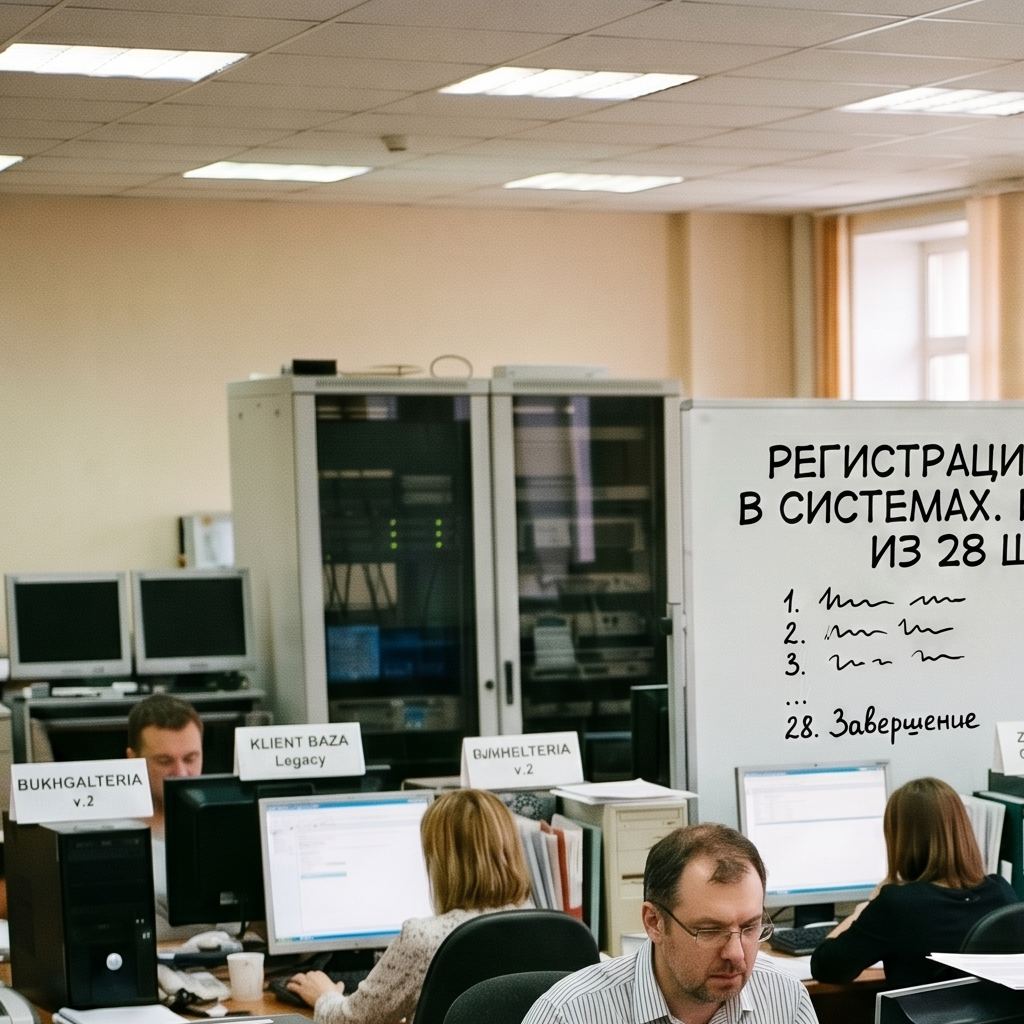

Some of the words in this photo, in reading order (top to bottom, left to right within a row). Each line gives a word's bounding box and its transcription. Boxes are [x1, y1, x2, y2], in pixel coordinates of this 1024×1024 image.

[739, 490, 763, 526] В
[779, 487, 1002, 525] СИСТЕМАХ.
[871, 534, 922, 569] ИЗ
[937, 533, 987, 568] 28
[783, 588, 800, 614] 1.
[783, 621, 806, 645] 2.
[784, 652, 806, 677] 3.
[784, 714, 819, 740] 28.
[828, 705, 981, 746] Завершение
[250, 736, 303, 750] KLIENT
[308, 734, 349, 748] BAZA
[275, 755, 326, 770] Legacy
[514, 763, 533, 775] v.2
[17, 773, 143, 792] BUKHGALTERIA
[73, 795, 94, 808] v.2
